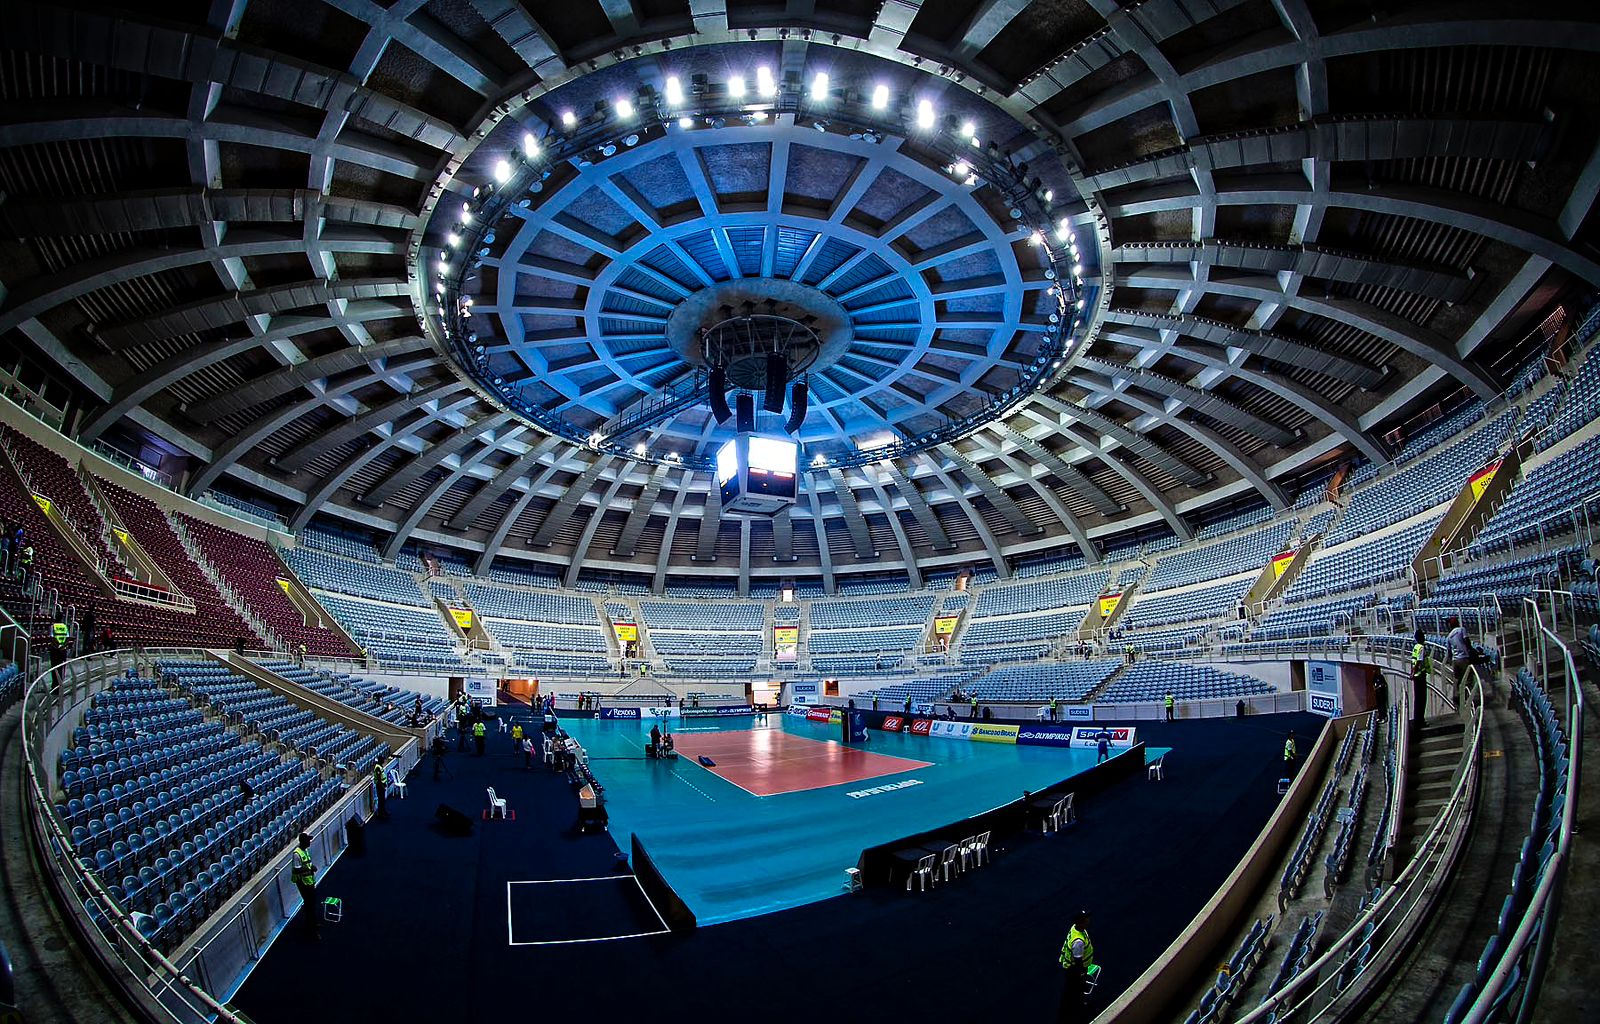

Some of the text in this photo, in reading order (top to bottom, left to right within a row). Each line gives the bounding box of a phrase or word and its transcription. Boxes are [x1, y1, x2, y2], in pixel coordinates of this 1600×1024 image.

[1312, 698, 1334, 710] SUDERJ
[613, 708, 636, 716] Rexona
[1035, 732, 1070, 741] OLYMPIKUS
